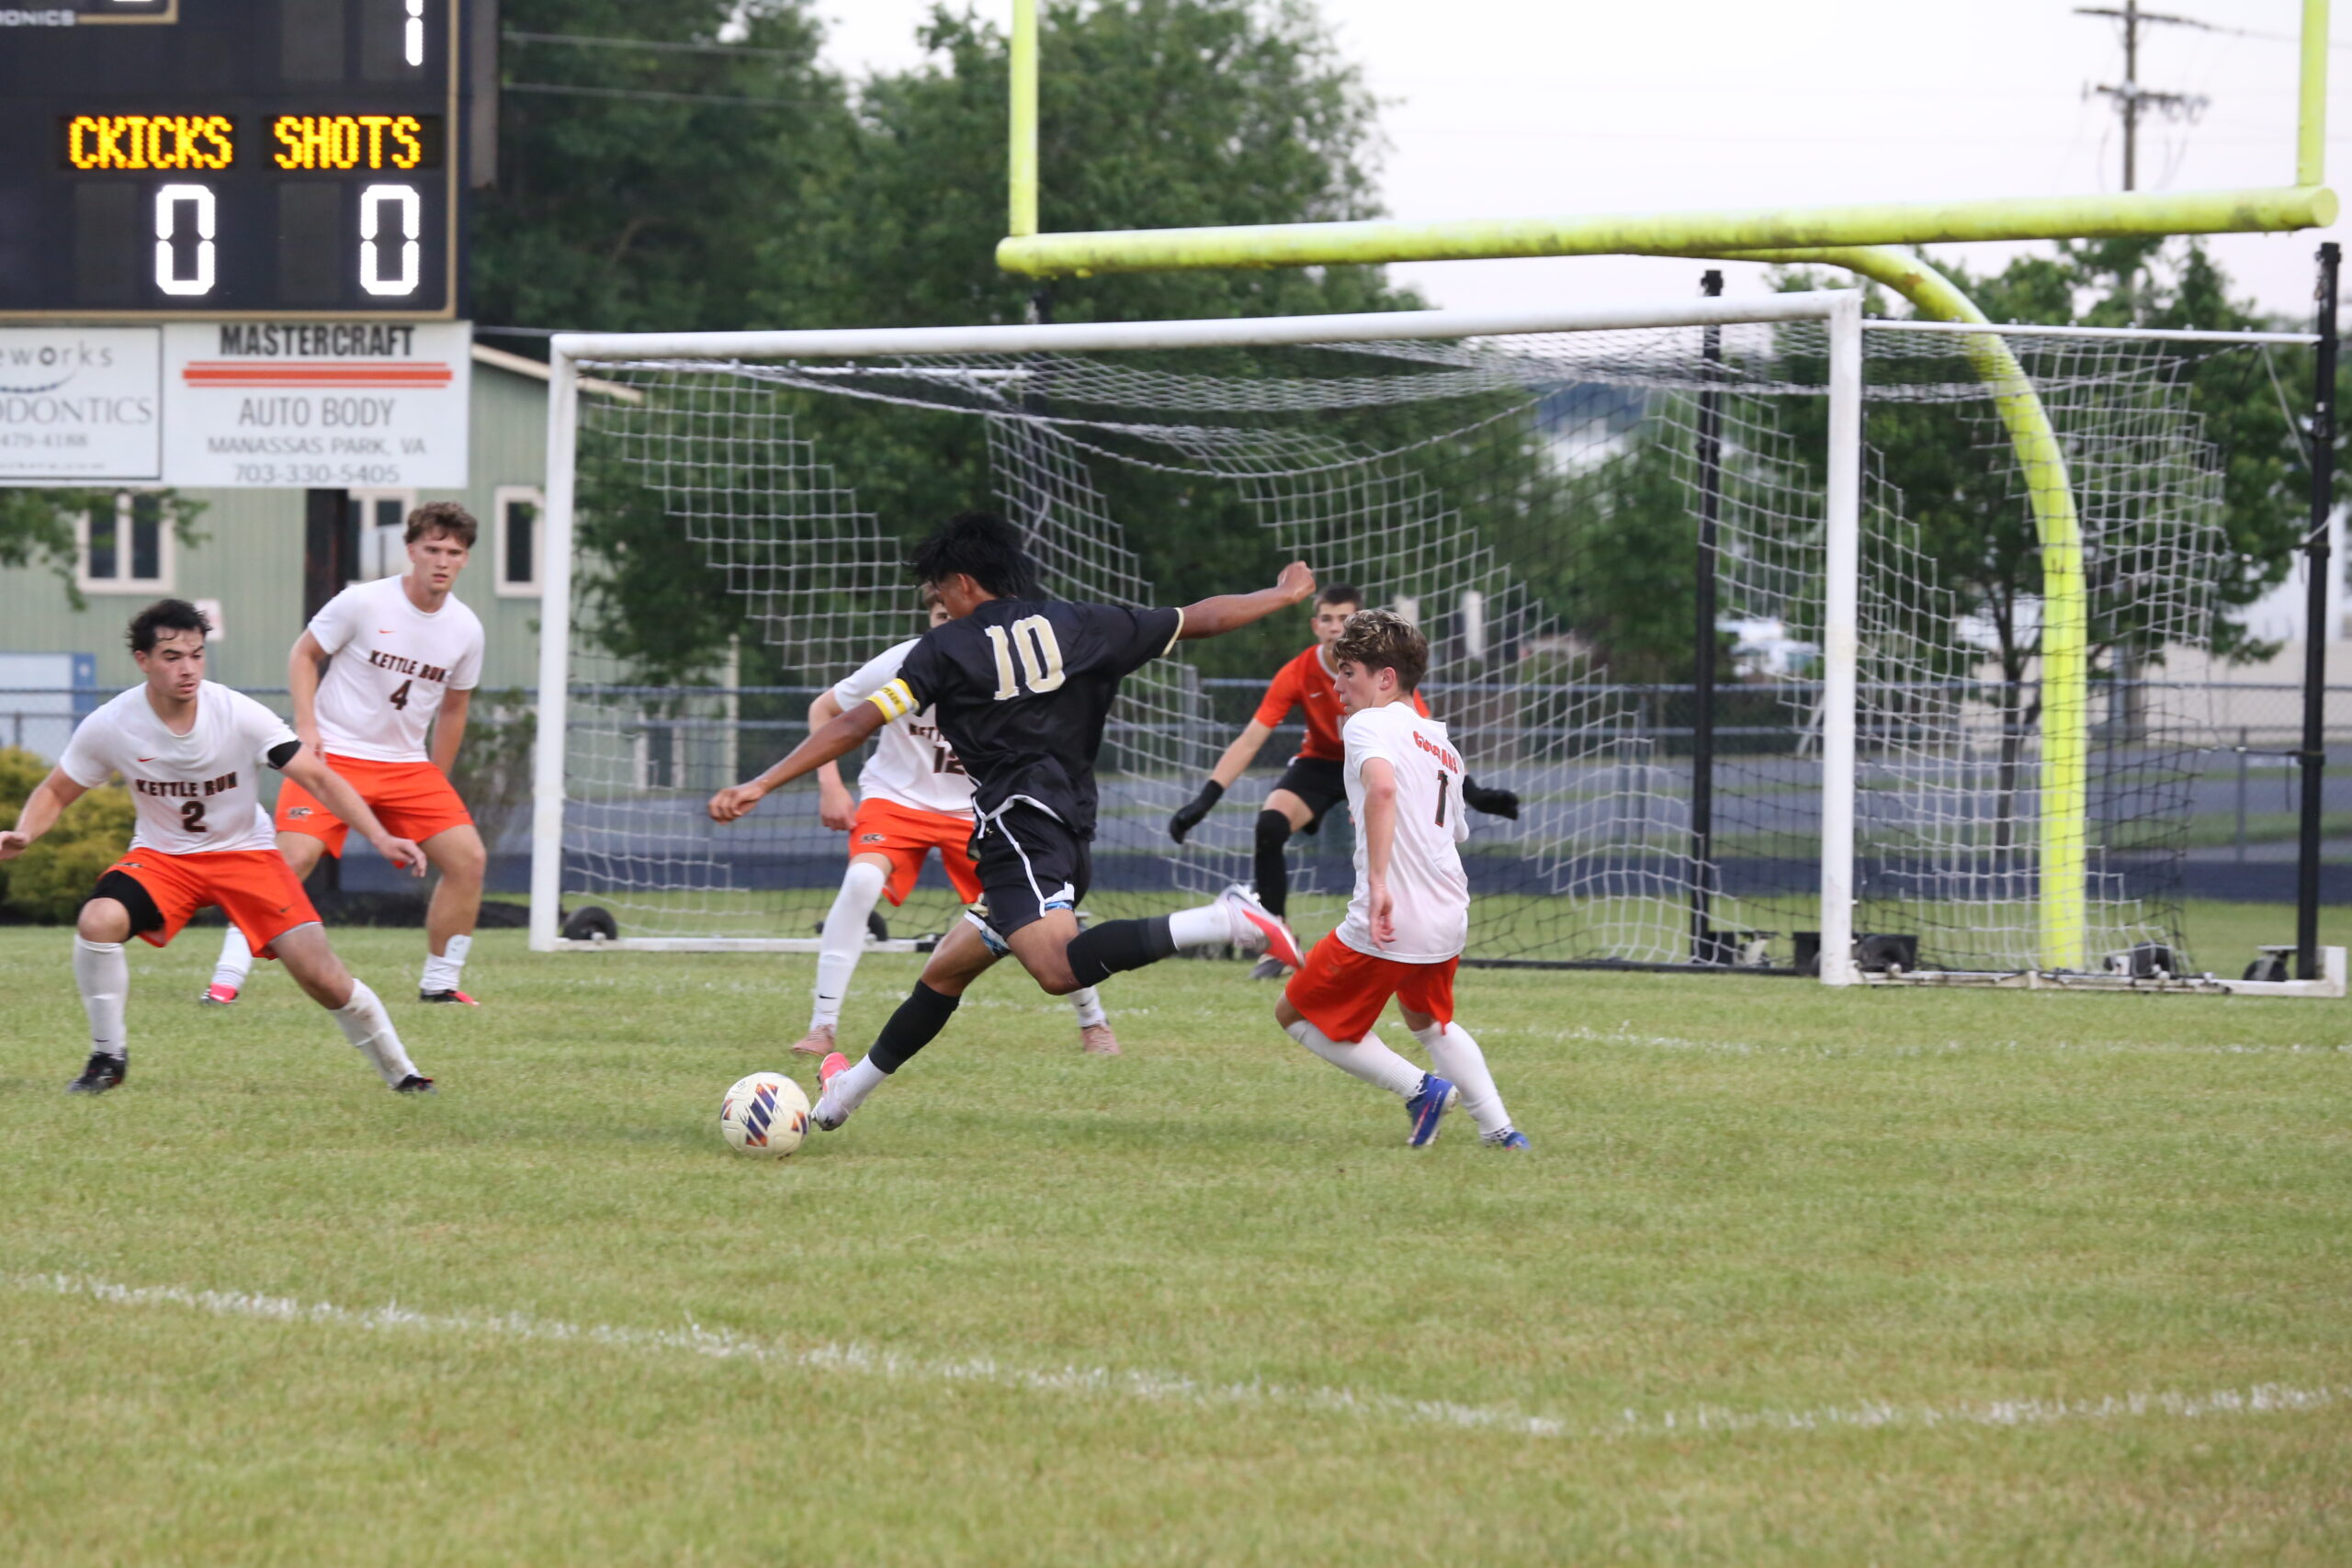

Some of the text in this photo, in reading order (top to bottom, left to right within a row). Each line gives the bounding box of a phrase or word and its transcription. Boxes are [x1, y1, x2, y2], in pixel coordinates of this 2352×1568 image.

[70, 116, 421, 169] CKICKS SHOTS
[155, 185, 215, 296] 0
[360, 185, 420, 296] 0
[219, 324, 416, 356] MASTERCRAFT
[0, 396, 153, 425] DONTICS
[238, 397, 396, 427] AUTO BODY
[208, 437, 426, 457] MANASSAS PARK, VA
[234, 463, 401, 484] 703-330-5405
[368, 649, 447, 682] KETTLE RUN
[984, 614, 1066, 701] 10
[390, 680, 413, 711] 4
[933, 745, 966, 776] 12
[136, 772, 237, 797] KETTLE RUN
[1435, 770, 1448, 828] 1
[181, 800, 207, 833] 2
